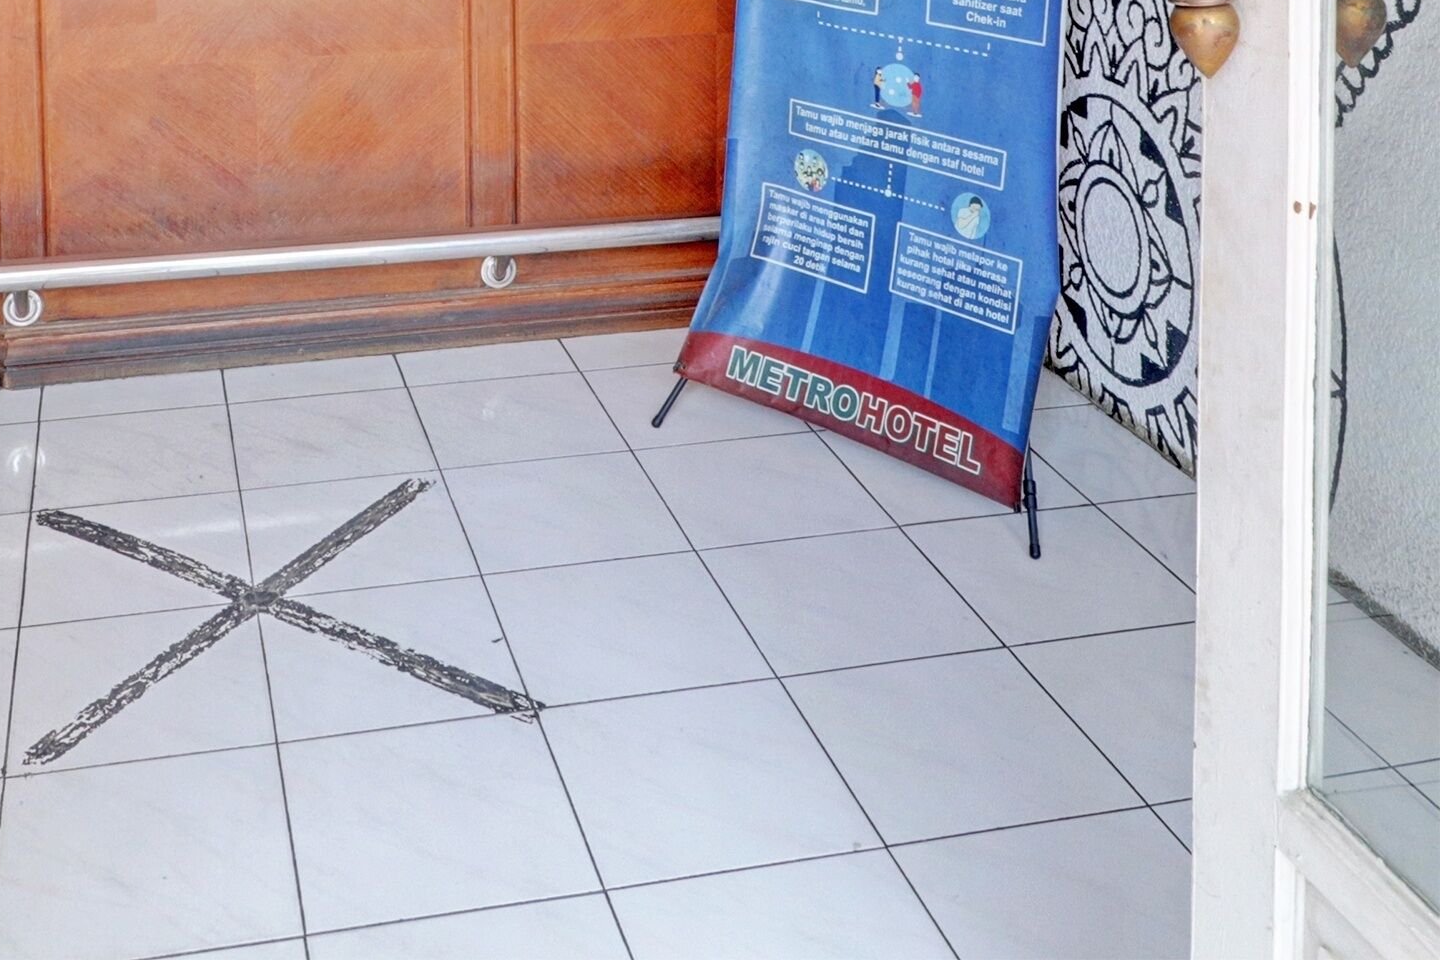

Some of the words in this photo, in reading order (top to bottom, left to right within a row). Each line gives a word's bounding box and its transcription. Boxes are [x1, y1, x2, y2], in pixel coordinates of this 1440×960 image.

[966, 11, 1007, 28] Chek-in
[1000, 5, 1023, 17] saat
[796, 105, 819, 120] Tamu
[820, 112, 844, 127] wajib
[846, 118, 884, 137] menjaga
[885, 126, 908, 142] jarak
[910, 133, 930, 146] fisik
[931, 137, 961, 155] antara
[962, 147, 999, 166] sesama
[805, 122, 827, 135] tamu
[829, 129, 849, 141] atau
[850, 133, 879, 150] antara
[881, 141, 905, 155] tamu
[906, 146, 940, 165] dengan
[941, 155, 960, 169] staf
[960, 161, 985, 177] hotel
[769, 189, 790, 202] Tamu
[791, 196, 811, 209] wajib
[812, 204, 869, 228] menggunakan
[769, 202, 798, 217] masker
[800, 211, 808, 219] di
[808, 214, 826, 226] area
[826, 218, 847, 233] hotel
[848, 227, 865, 238] dan
[763, 224, 792, 238] selama
[794, 233, 833, 252] menginap
[834, 245, 865, 262] dengan
[767, 212, 813, 233] berperilaku
[813, 226, 836, 243] hidup
[837, 234, 864, 249] bersih
[762, 235, 780, 246] rajin
[782, 240, 801, 253] cuci
[802, 247, 831, 262] tangan
[832, 257, 861, 273] selama
[793, 255, 804, 265] 20
[805, 260, 826, 273] detik
[907, 245, 930, 259] pihak
[932, 252, 954, 267] hotel
[955, 259, 972, 272] jika
[973, 267, 1007, 284] merasa
[909, 232, 932, 247] Tamu
[933, 241, 957, 255] wajib
[958, 249, 995, 266] melapor
[997, 260, 1008, 271] ke
[896, 267, 942, 290] seseorang
[943, 282, 976, 300] dengan
[977, 292, 1012, 311] kondisi
[900, 254, 930, 273] kurang
[931, 264, 956, 279] sehat
[957, 274, 976, 287] atau
[978, 281, 1012, 299] melihat
[896, 278, 927, 297] kurang
[928, 289, 953, 304] sehat
[954, 298, 963, 308] di
[964, 302, 984, 315] area
[985, 308, 1009, 324] hotel
[725, 345, 981, 475] METROHOTEL
